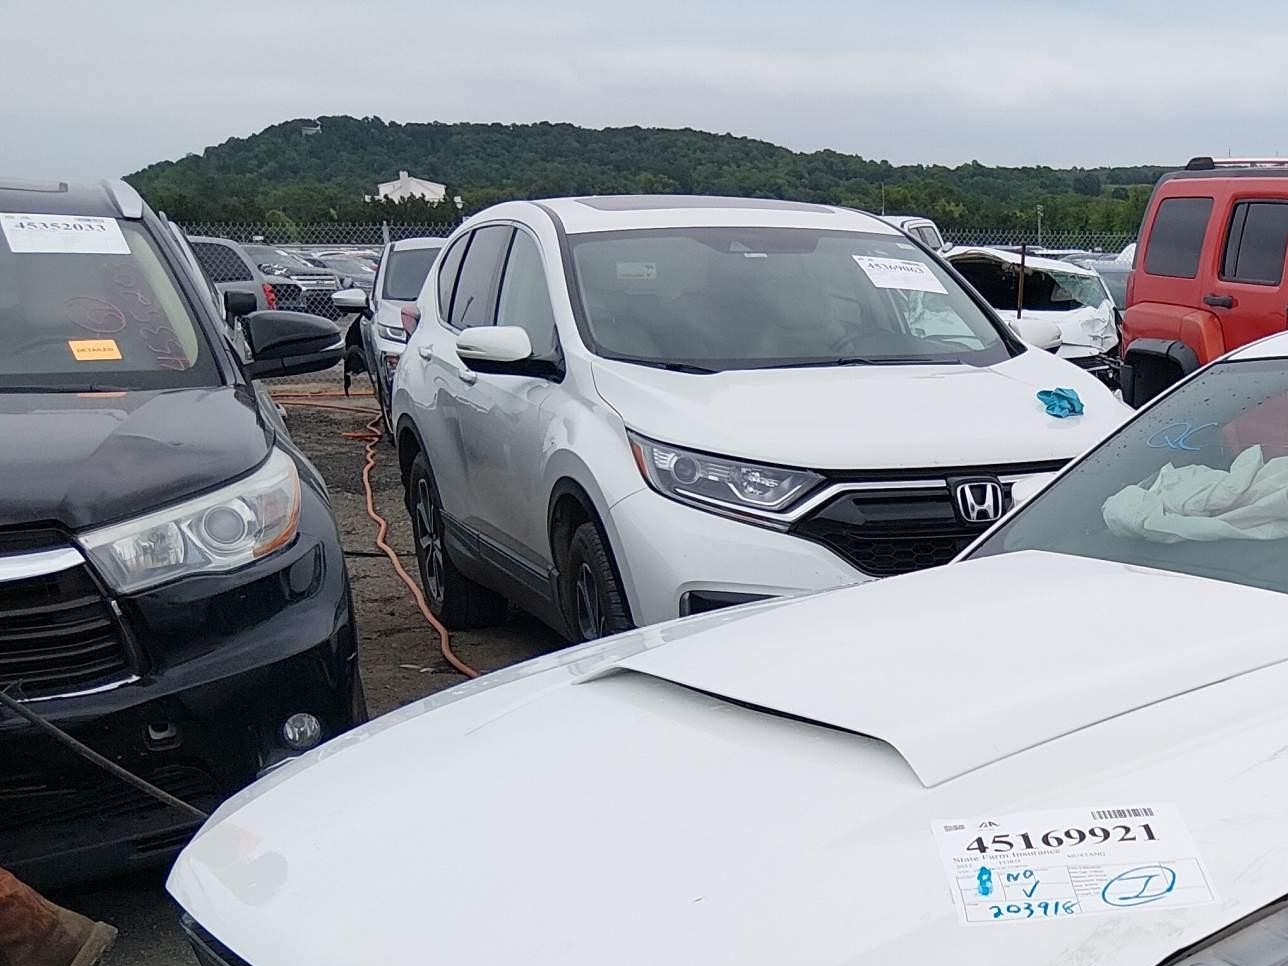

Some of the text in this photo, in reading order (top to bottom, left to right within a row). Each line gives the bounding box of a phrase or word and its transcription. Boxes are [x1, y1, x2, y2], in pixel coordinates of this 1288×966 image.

[15, 221, 106, 232] 45352033
[966, 822, 1161, 855] 45169921
[982, 853, 1009, 861] Farm
[1012, 849, 1061, 858] Insurance
[989, 901, 1076, 918] 203918
